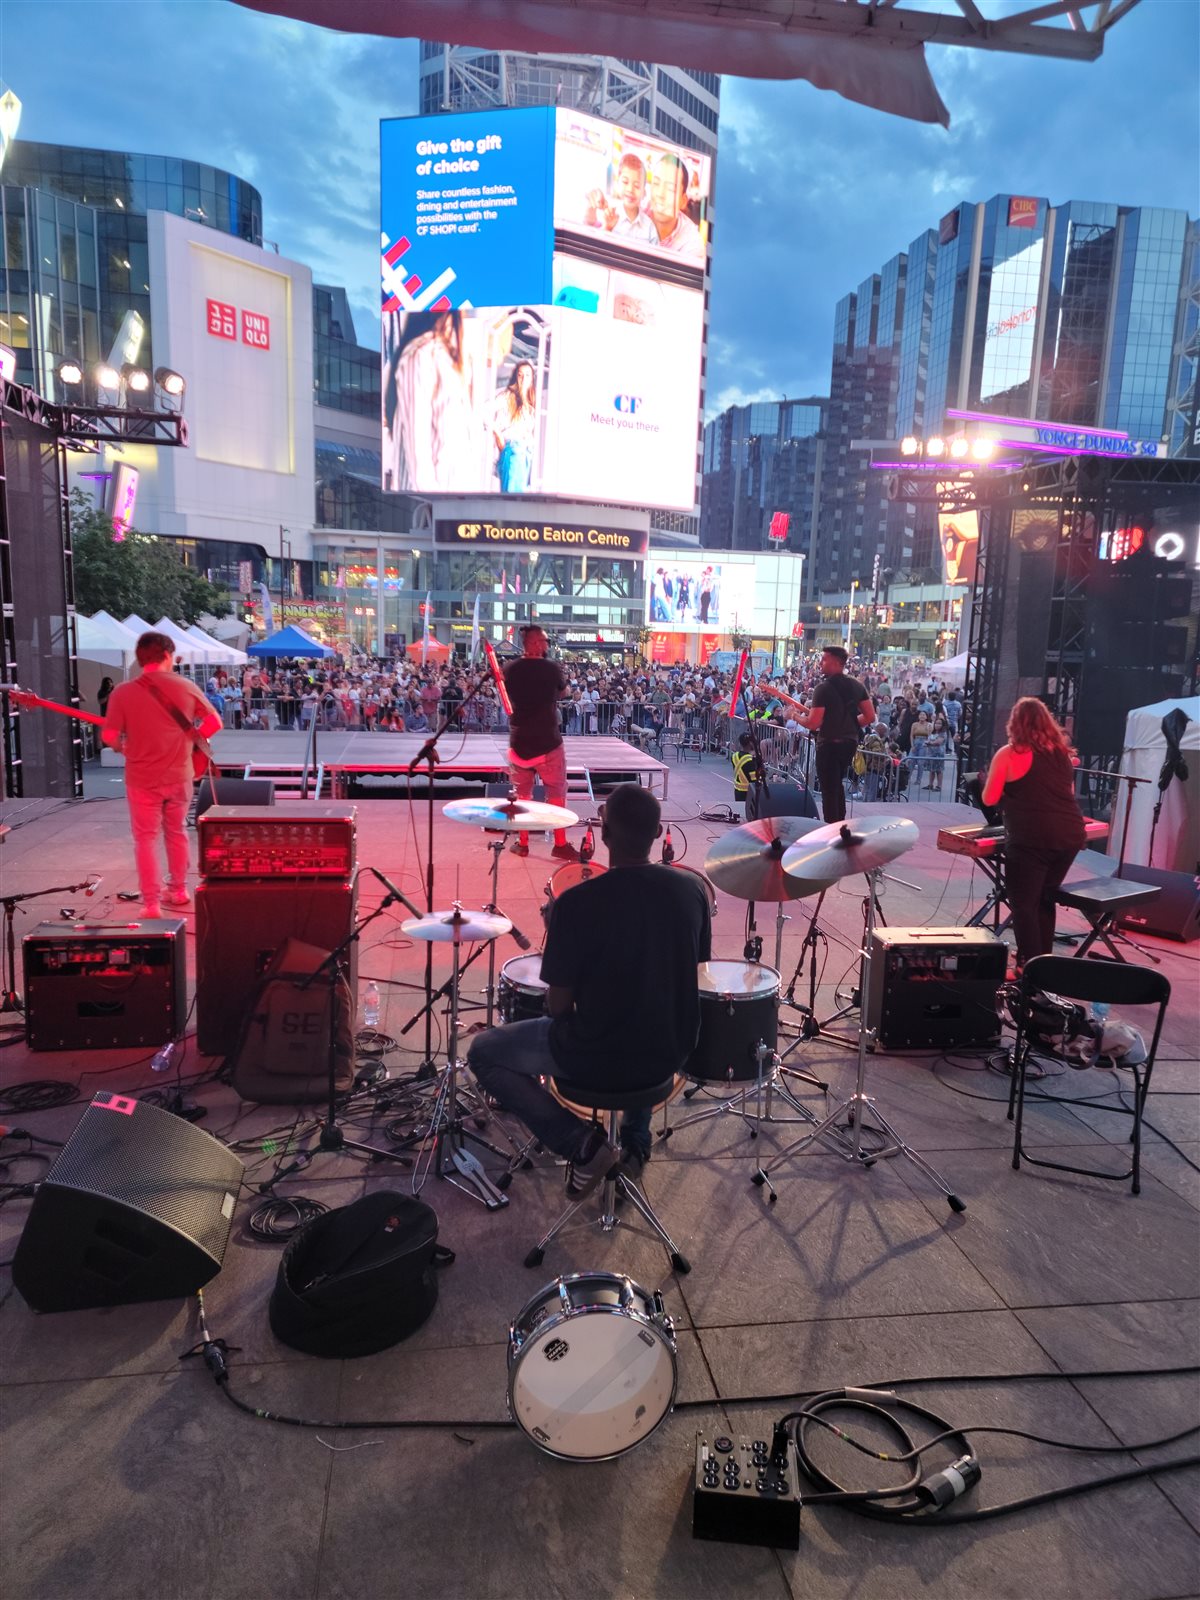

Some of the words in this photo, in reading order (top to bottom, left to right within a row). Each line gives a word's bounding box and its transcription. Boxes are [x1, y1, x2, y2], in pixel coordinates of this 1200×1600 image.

[416, 140, 448, 155] Give
[450, 138, 474, 153] the
[476, 135, 502, 154] gift
[416, 160, 432, 175] of
[433, 157, 480, 174] choice
[416, 190, 440, 199] Share
[441, 187, 481, 198] countless
[481, 185, 515, 195] fashion,
[416, 202, 441, 212] dining
[443, 200, 459, 210] and
[459, 197, 518, 209] entertainment
[1012, 199, 1036, 211] CIBC
[416, 212, 463, 225] possibilities
[464, 211, 482, 221] with
[483, 210, 498, 220] the
[416, 226, 428, 236] CF
[429, 224, 457, 235] SHOP!
[245, 314, 265, 332] UNI
[246, 329, 267, 346] QLO
[613, 394, 642, 414] CF
[590, 412, 614, 426] Meet
[616, 419, 634, 429] you
[636, 421, 660, 432] there
[1141, 440, 1158, 457] SQ
[457, 523, 481, 539] CF
[483, 524, 540, 541] Toronto
[543, 527, 584, 543] Eaton
[587, 530, 631, 547] Centre
